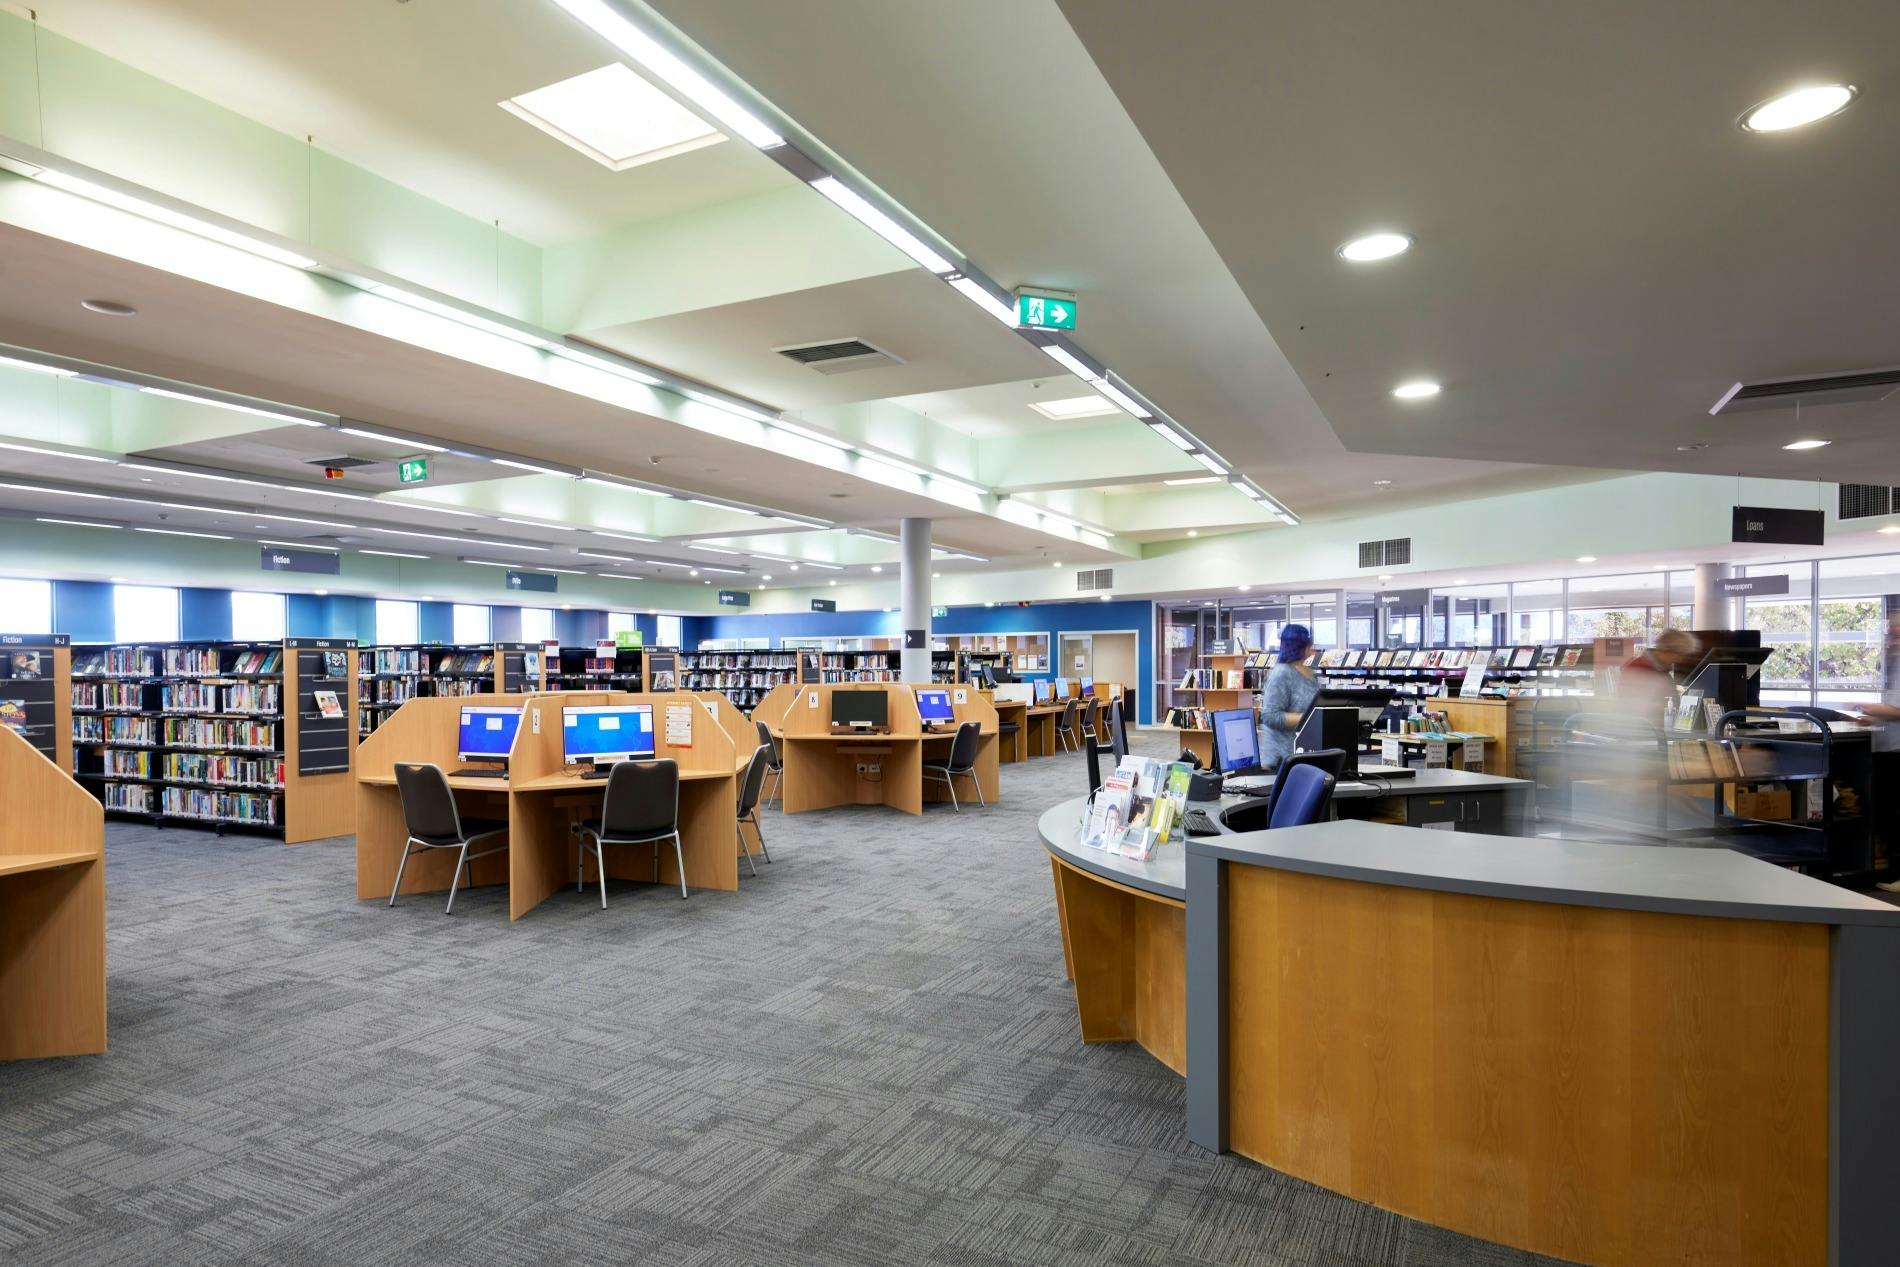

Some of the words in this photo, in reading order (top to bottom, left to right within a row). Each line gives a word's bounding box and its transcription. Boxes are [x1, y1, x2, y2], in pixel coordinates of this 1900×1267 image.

[1746, 519, 1764, 532] Loans
[273, 554, 291, 565] Fiction
[1724, 582, 1753, 593] Newspapers
[2, 635, 23, 644] Fiction
[316, 640, 330, 648] Fiction
[957, 692, 963, 700] 9
